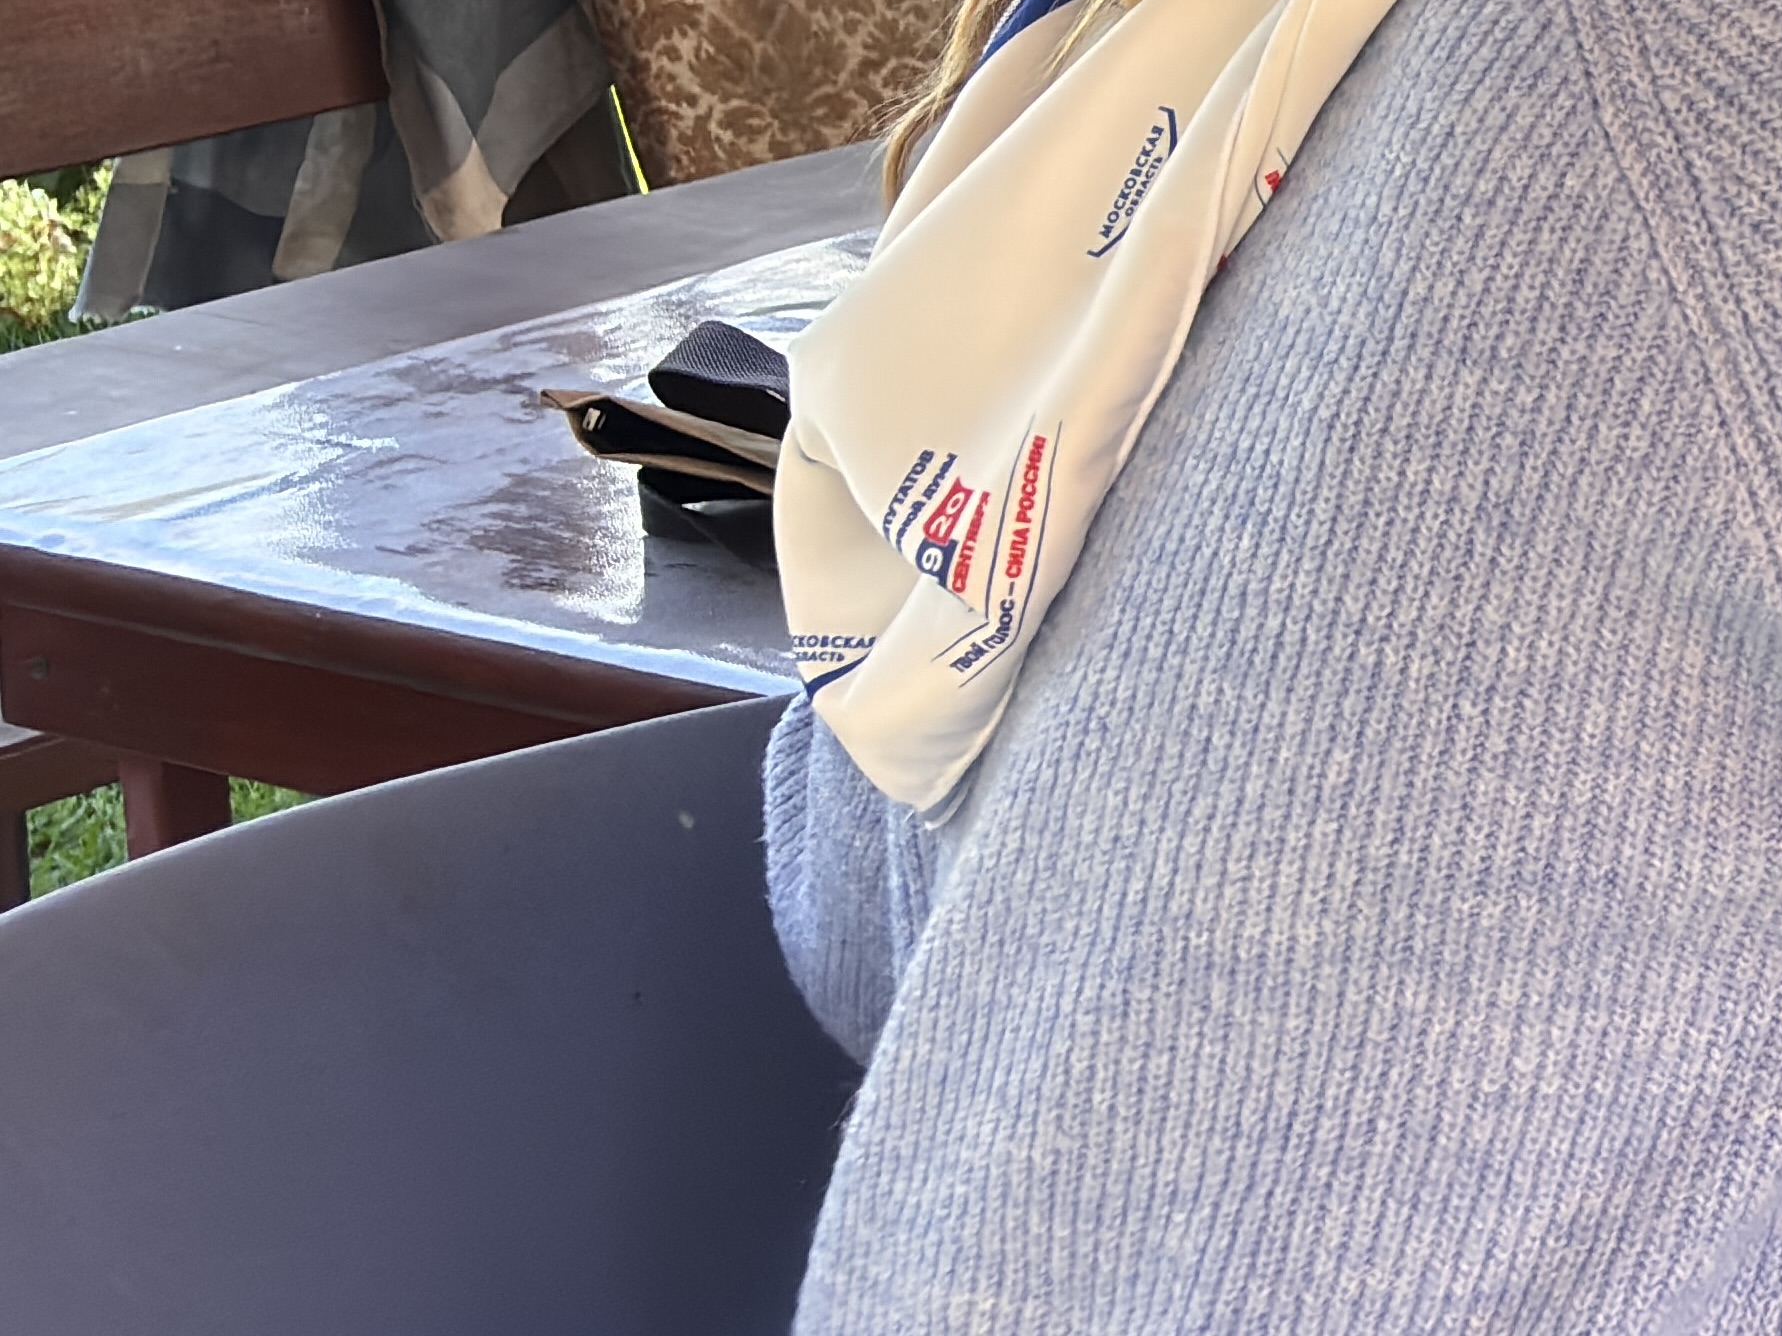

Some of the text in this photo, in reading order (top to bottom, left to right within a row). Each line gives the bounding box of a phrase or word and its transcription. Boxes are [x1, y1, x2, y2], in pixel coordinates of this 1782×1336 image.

[1099, 125, 1165, 239] МОСКОВСКАЯ
[1125, 156, 1163, 217] ОБЛАСТЬ
[921, 491, 965, 573] 9 20
[949, 641, 989, 673] ТВОЙ
[982, 598, 1016, 649] ГОЛОС
[1005, 527, 1031, 579] СИЛА
